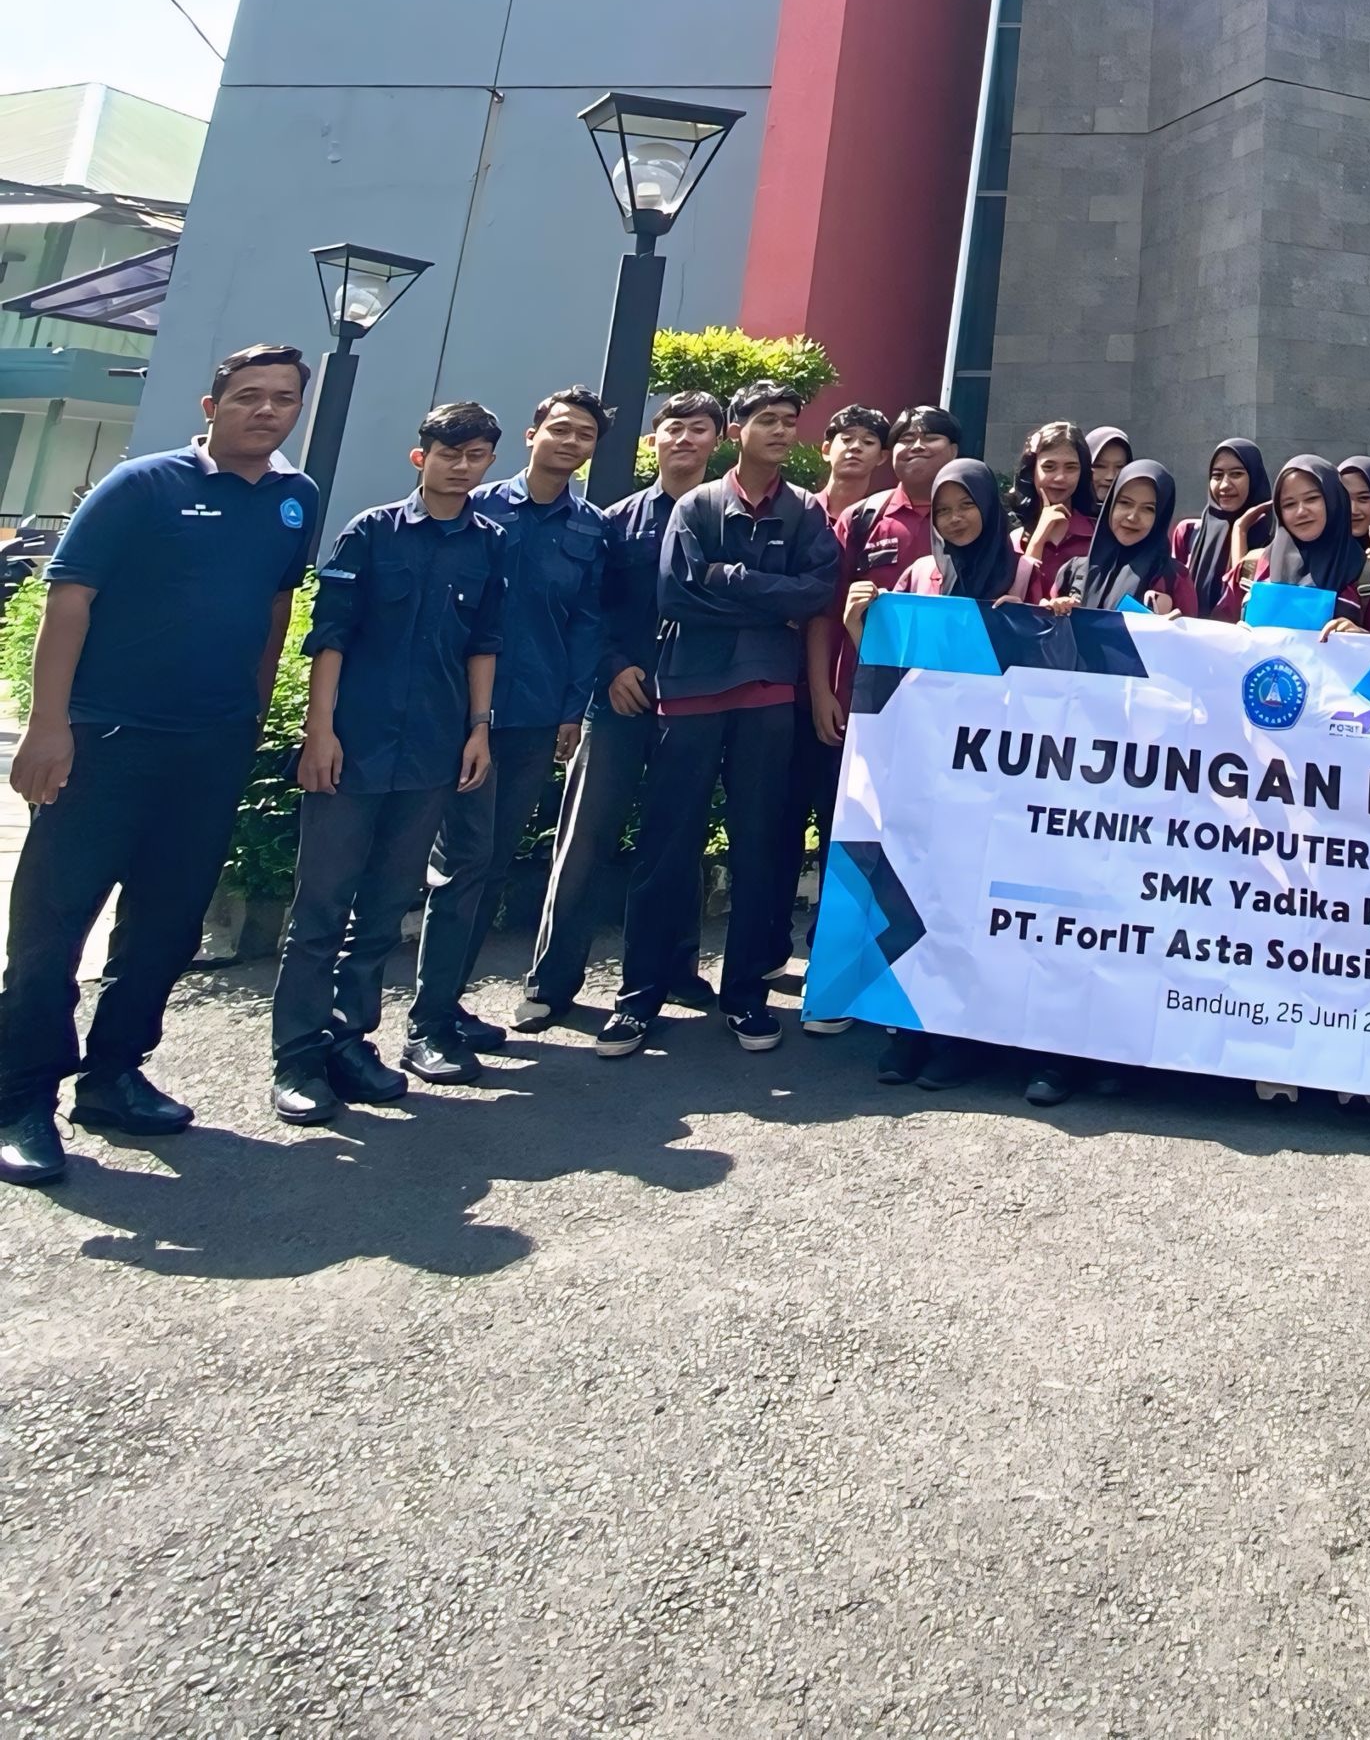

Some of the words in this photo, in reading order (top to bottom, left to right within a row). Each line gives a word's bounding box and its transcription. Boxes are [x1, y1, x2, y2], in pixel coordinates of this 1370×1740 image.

[952, 726, 1341, 811] KUNJUNGAN
[1027, 804, 1154, 845] TEKNIK
[1166, 818, 1370, 870] KOMPUTER
[1140, 871, 1214, 907] SMK
[1228, 879, 1351, 924] Yadika
[989, 907, 1044, 943] PT.
[1054, 916, 1155, 955] ForIT
[1165, 928, 1253, 966] Asta
[1166, 989, 1270, 1025] Bandung,
[1276, 1002, 1304, 1024] 25
[1309, 1005, 1357, 1030] Juni
